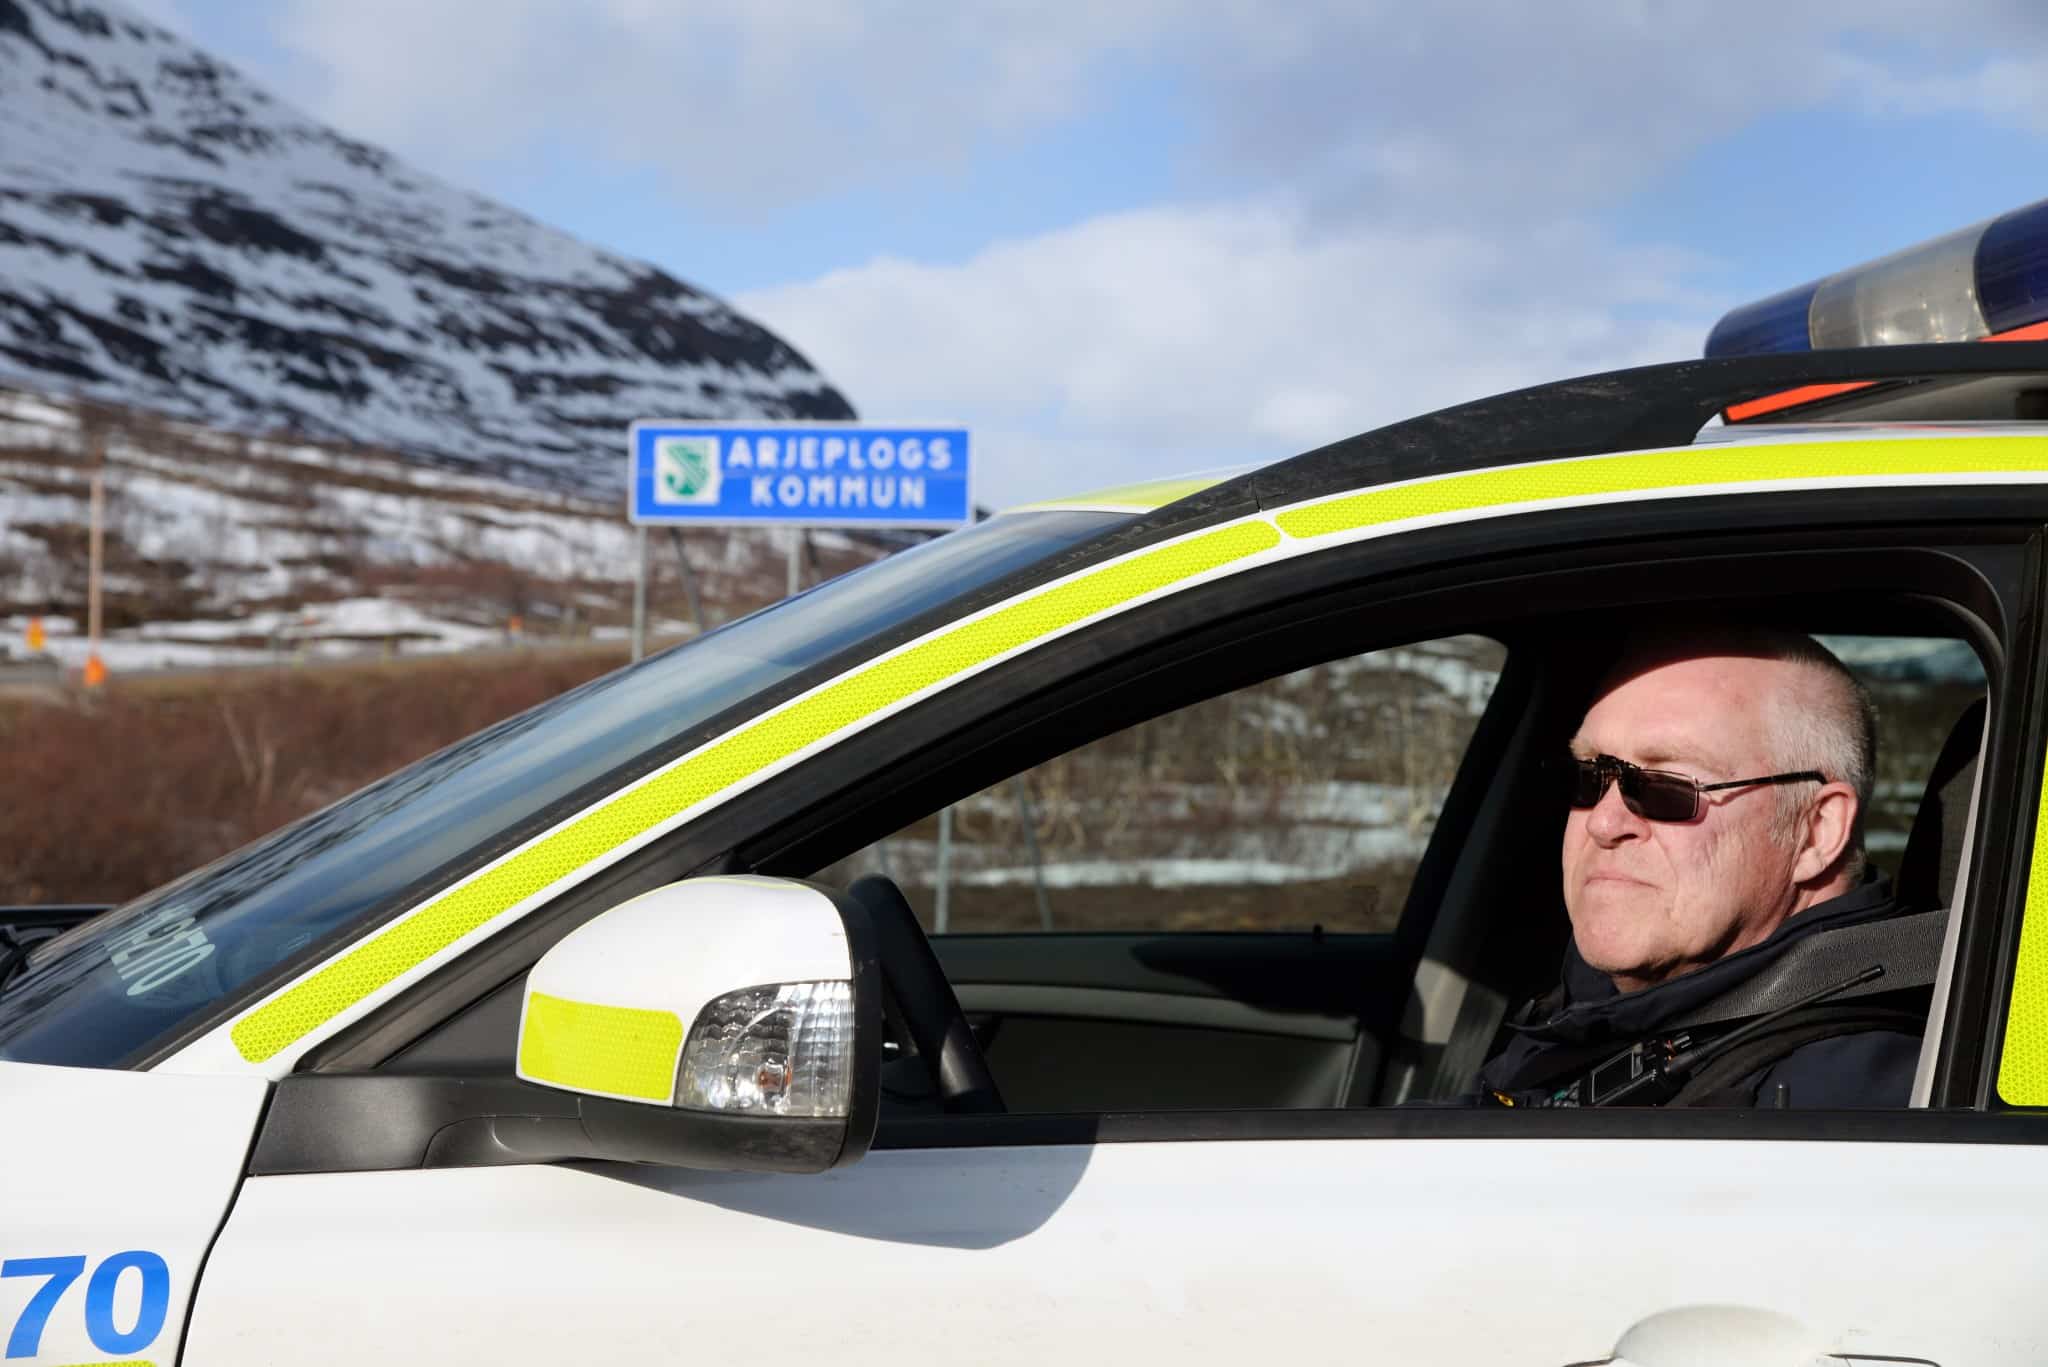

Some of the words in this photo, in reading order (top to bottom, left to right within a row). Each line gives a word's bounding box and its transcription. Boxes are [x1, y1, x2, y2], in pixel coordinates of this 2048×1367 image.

[728, 437, 951, 469] ARJEPLOGS
[751, 476, 926, 508] KOMMUN
[0, 1250, 170, 1359] 70
